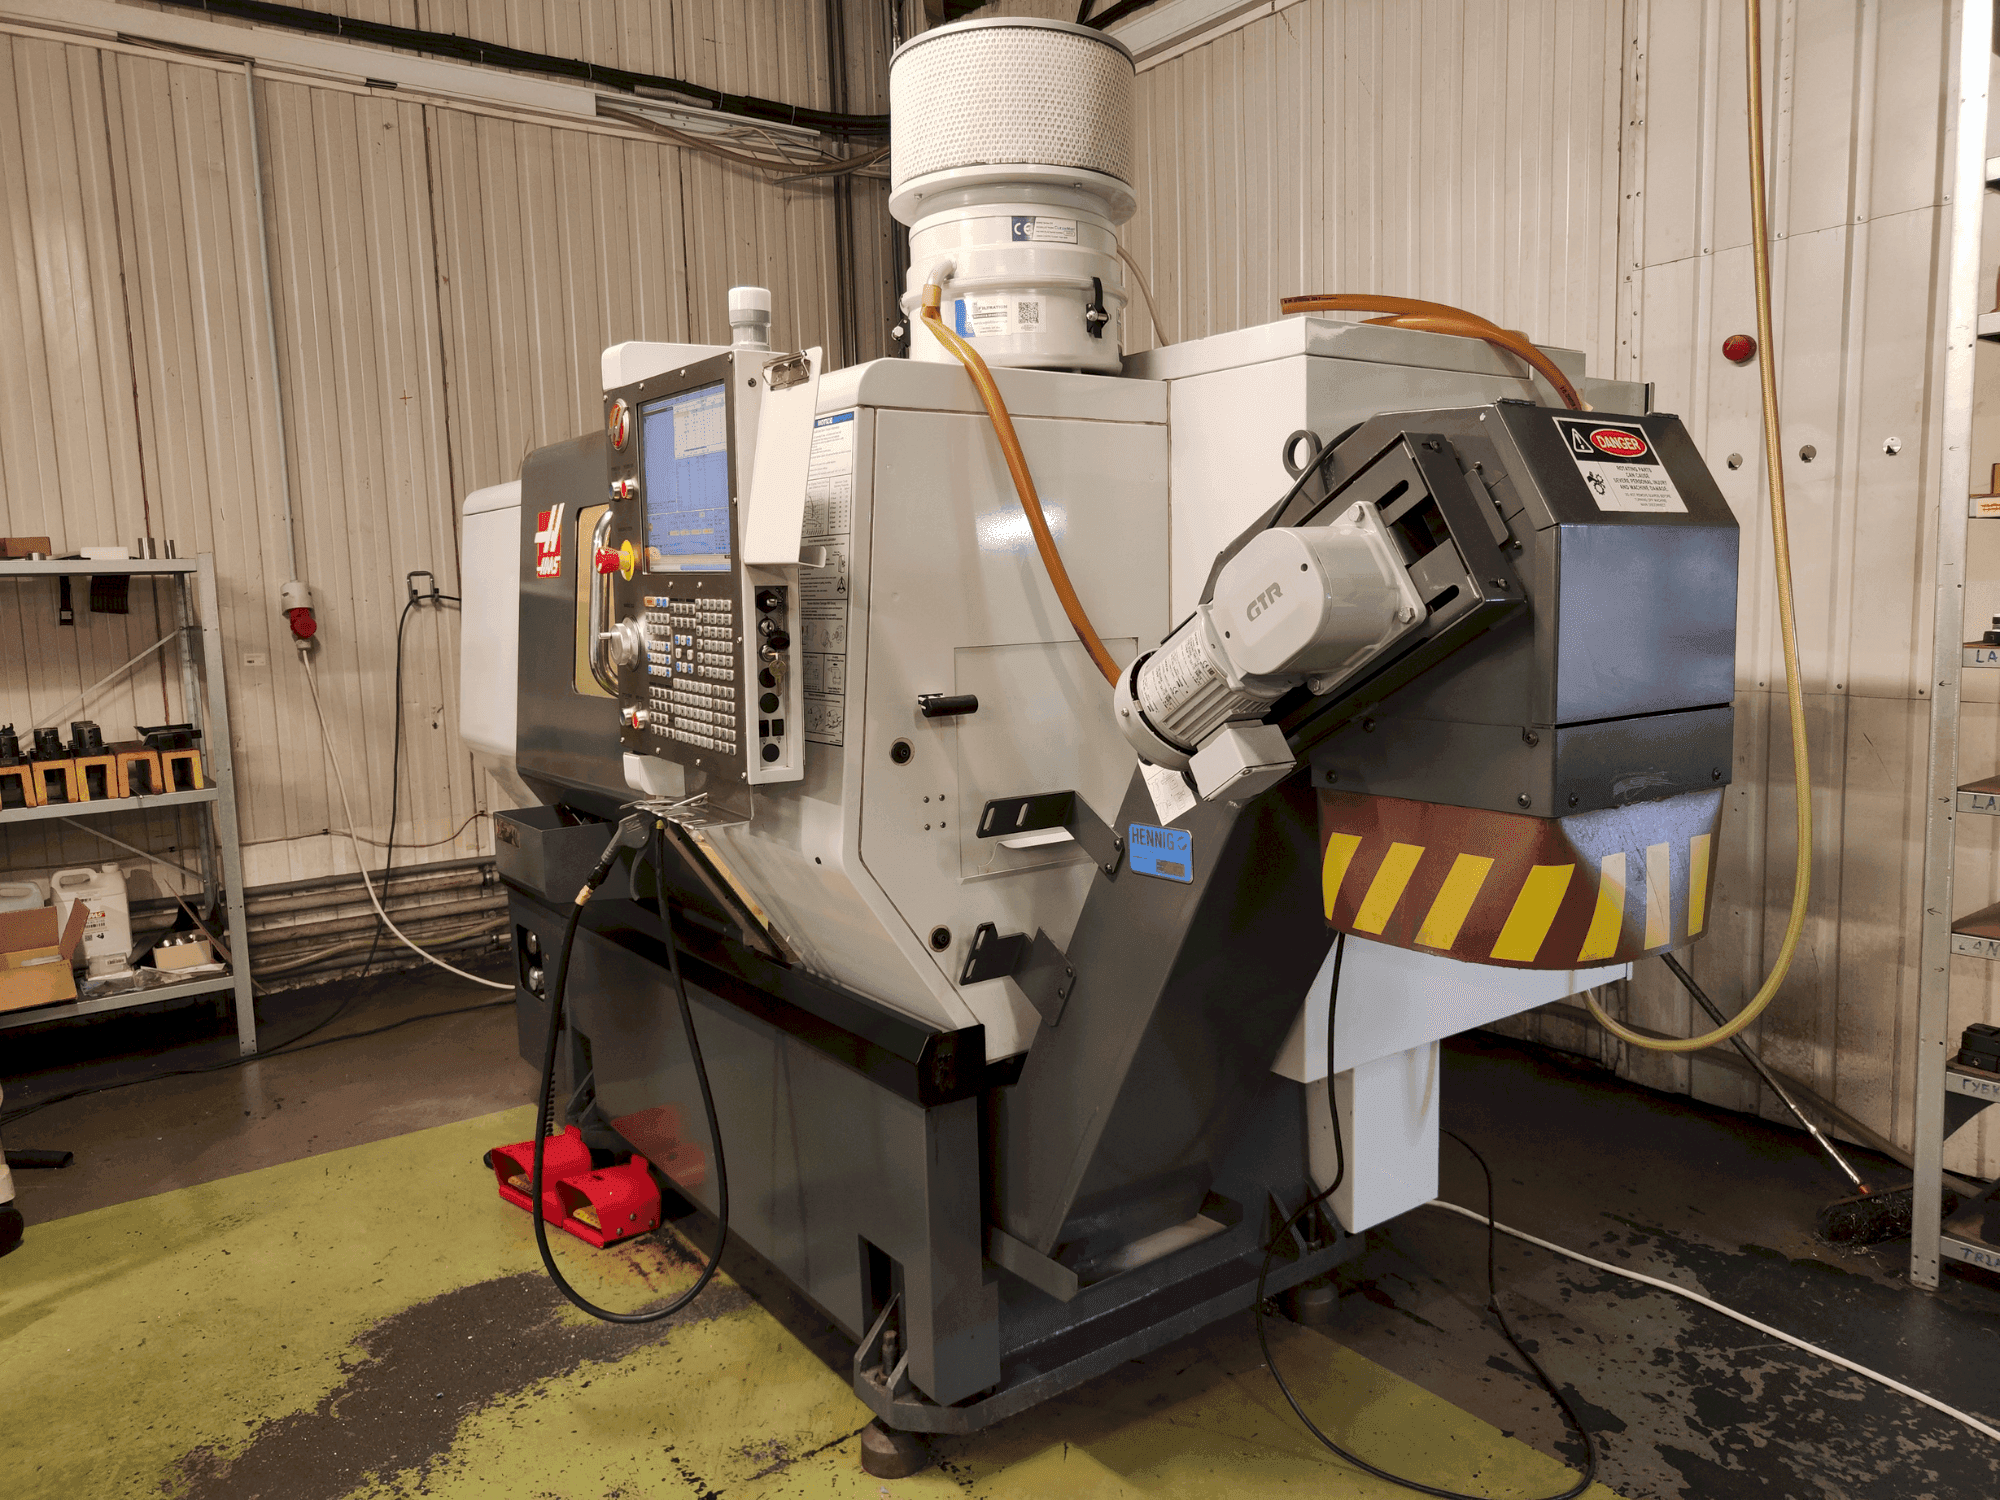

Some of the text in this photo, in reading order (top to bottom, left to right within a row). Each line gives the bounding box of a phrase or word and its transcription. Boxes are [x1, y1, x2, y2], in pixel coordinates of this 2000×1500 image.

[1595, 435, 1641, 450] DANGER
[1246, 582, 1283, 622] GTR
[1972, 794, 2000, 811] LA
[1131, 826, 1175, 851] HENNIG
